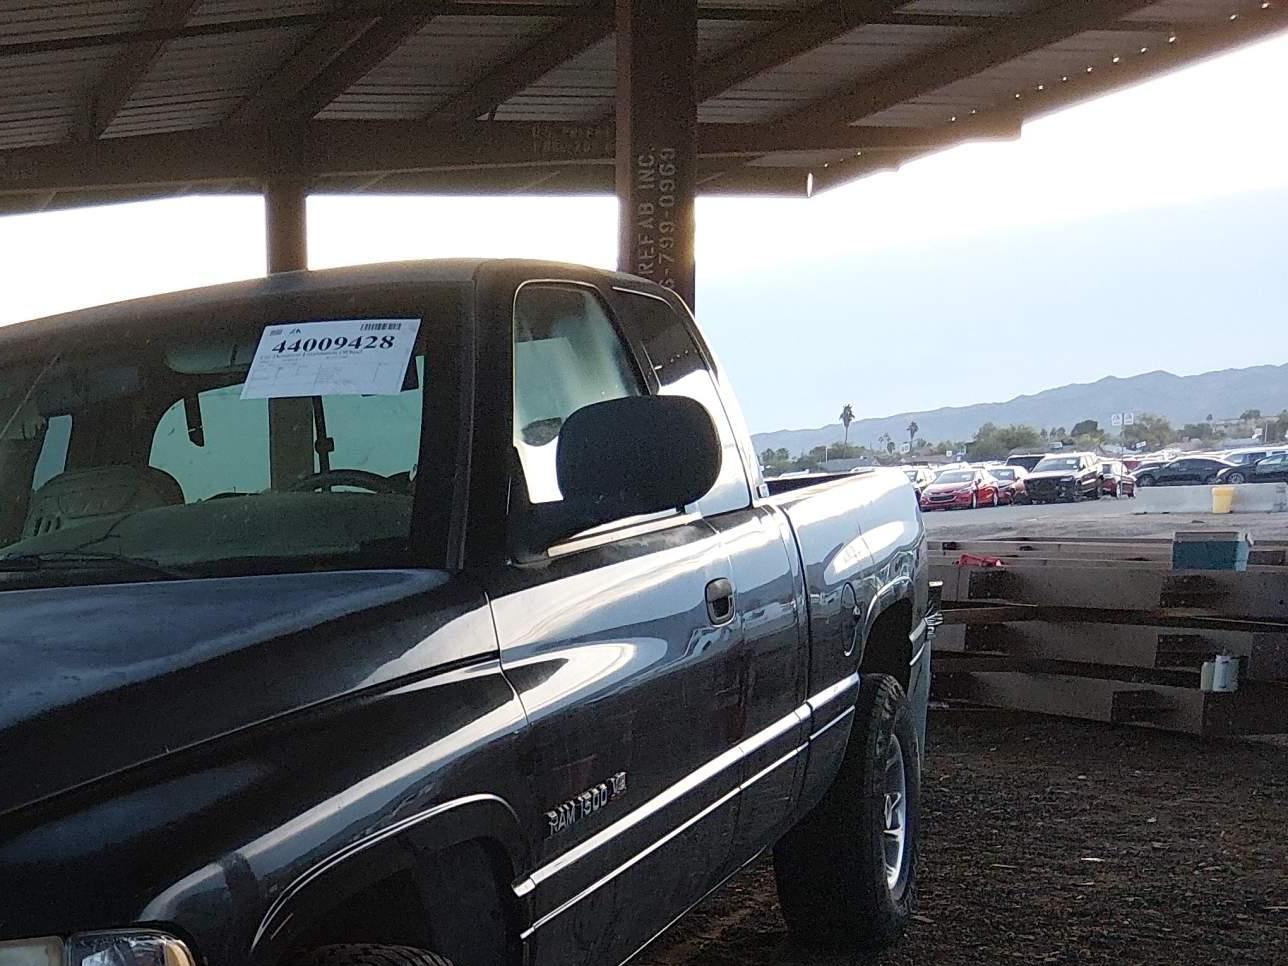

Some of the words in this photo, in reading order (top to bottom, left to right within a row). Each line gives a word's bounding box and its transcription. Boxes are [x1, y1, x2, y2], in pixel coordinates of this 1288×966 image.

[637, 146, 655, 190] INC.
[271, 335, 396, 354] 44009428
[545, 801, 576, 836] RAM
[577, 784, 608, 819] 1500
